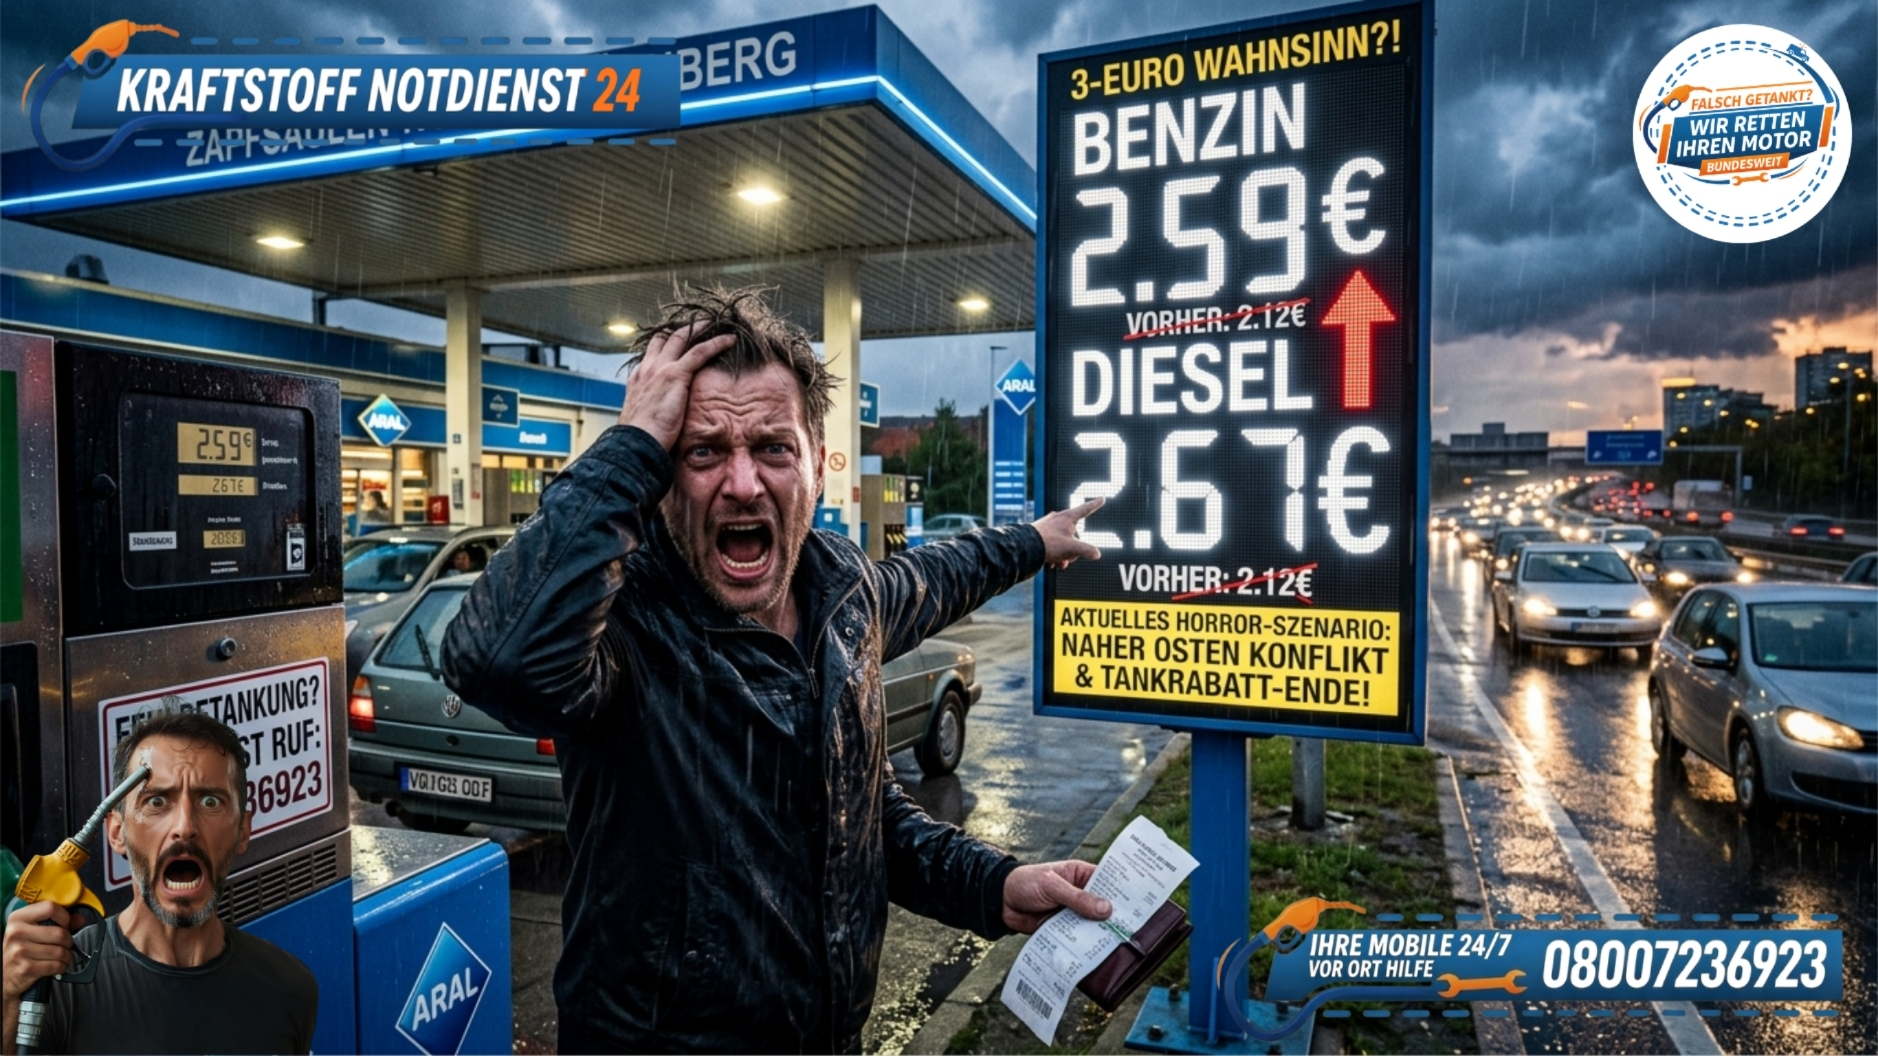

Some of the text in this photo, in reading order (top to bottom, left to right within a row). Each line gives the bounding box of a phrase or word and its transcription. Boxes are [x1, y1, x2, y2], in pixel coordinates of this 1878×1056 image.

[676, 31, 796, 91] BERG
[1070, 19, 1402, 101] 3-EURO WAHNSINN?!
[1073, 82, 1306, 176] BENZIN
[1125, 302, 1307, 337] VORHER: 2.12€
[1002, 379, 1036, 393] ARAL
[1071, 338, 1313, 417] DIESEL
[367, 412, 405, 431] ARAL
[196, 427, 252, 461] 2.59€
[1118, 563, 1313, 598] VORHER: 2.12€
[1060, 606, 1392, 642] AKTUELLES HORROR-SZENARIO:
[1061, 633, 1390, 675] NAHER OSTEN KONFLIKT
[1074, 662, 1371, 708] & TANKRABATT-ENDE!
[115, 674, 320, 745] FTANKUNG?
[272, 718, 321, 761] RUF:
[246, 760, 322, 817] 36923
[412, 966, 479, 1032] ARAL
